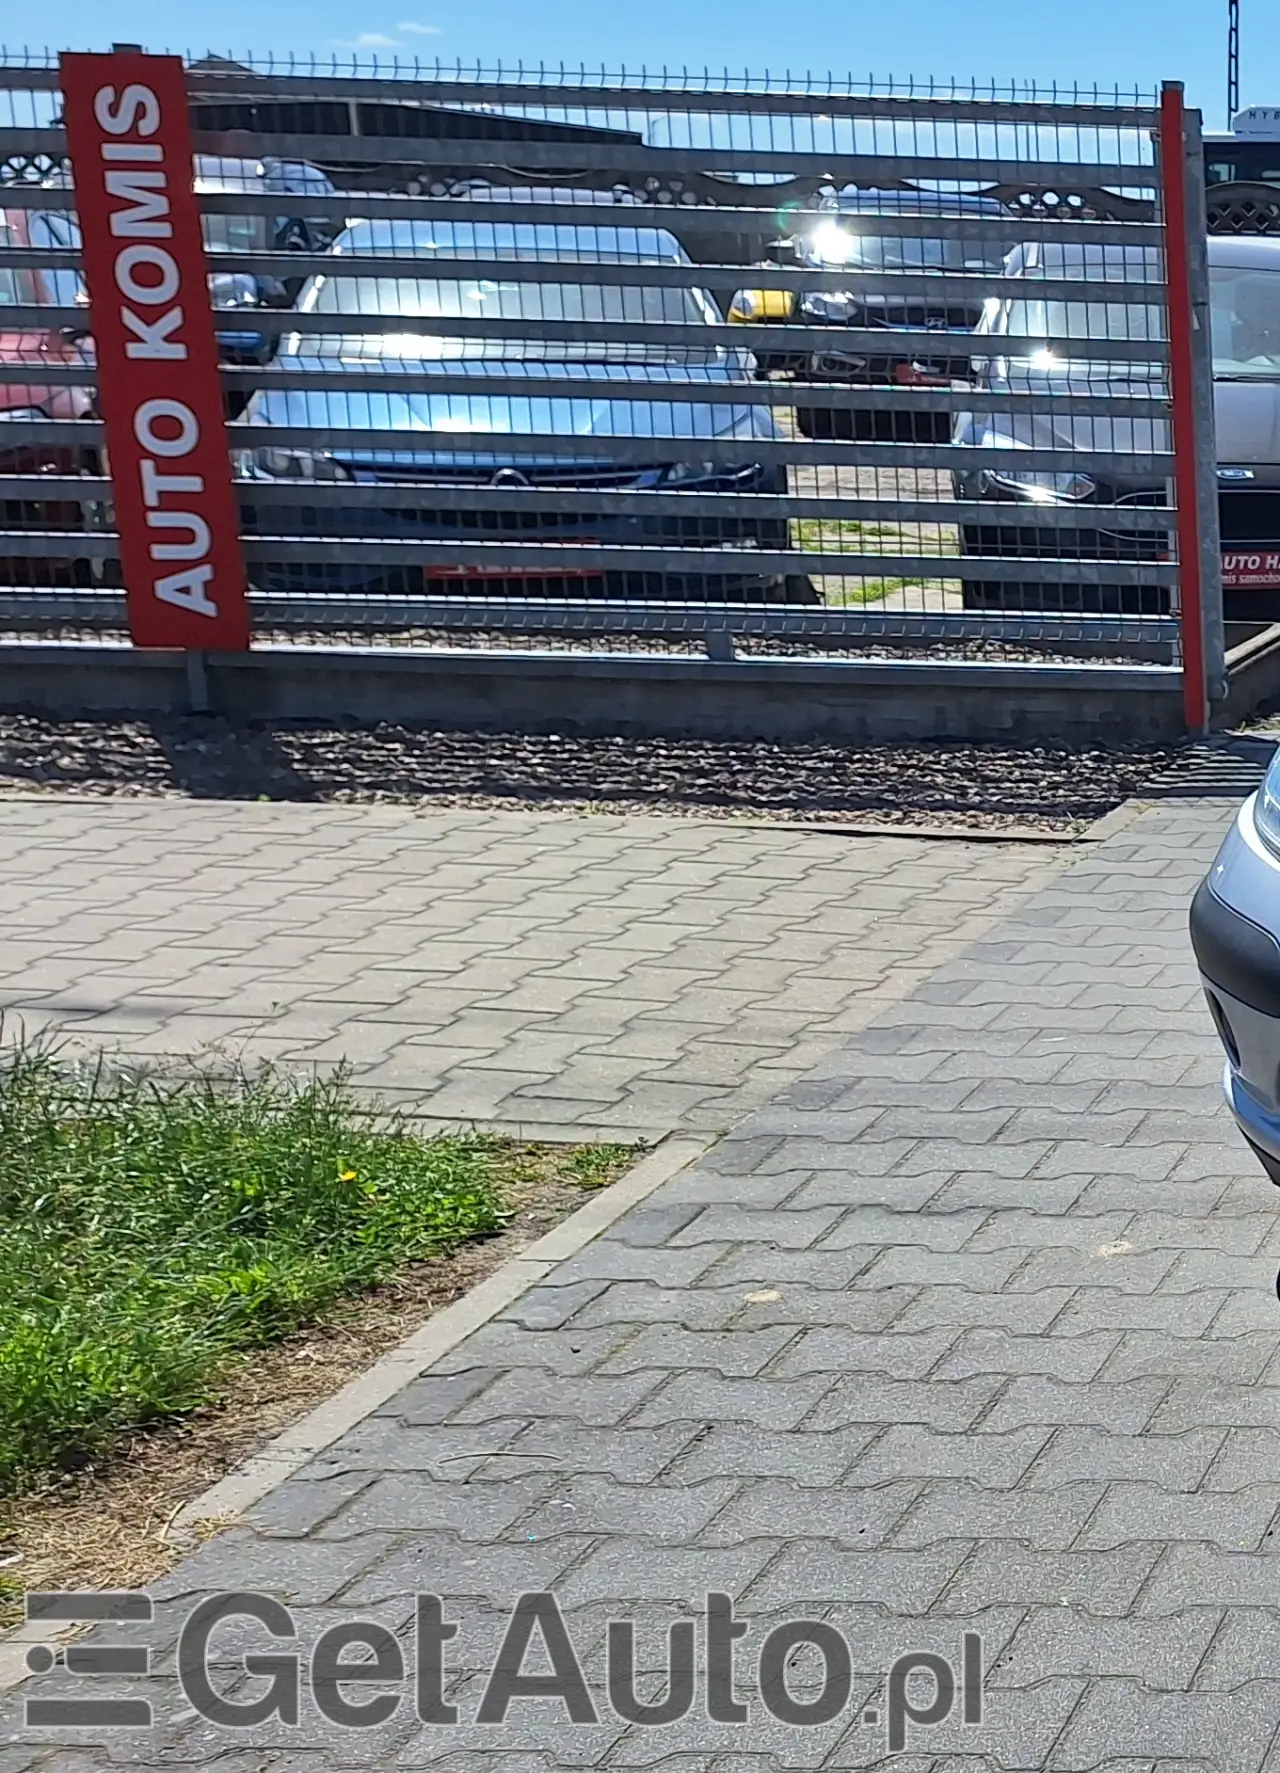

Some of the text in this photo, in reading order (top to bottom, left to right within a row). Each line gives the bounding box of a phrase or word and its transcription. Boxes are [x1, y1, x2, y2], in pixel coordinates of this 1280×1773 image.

[93, 83, 219, 618] AUTO KOMIS
[1220, 555, 1261, 570] UTO
